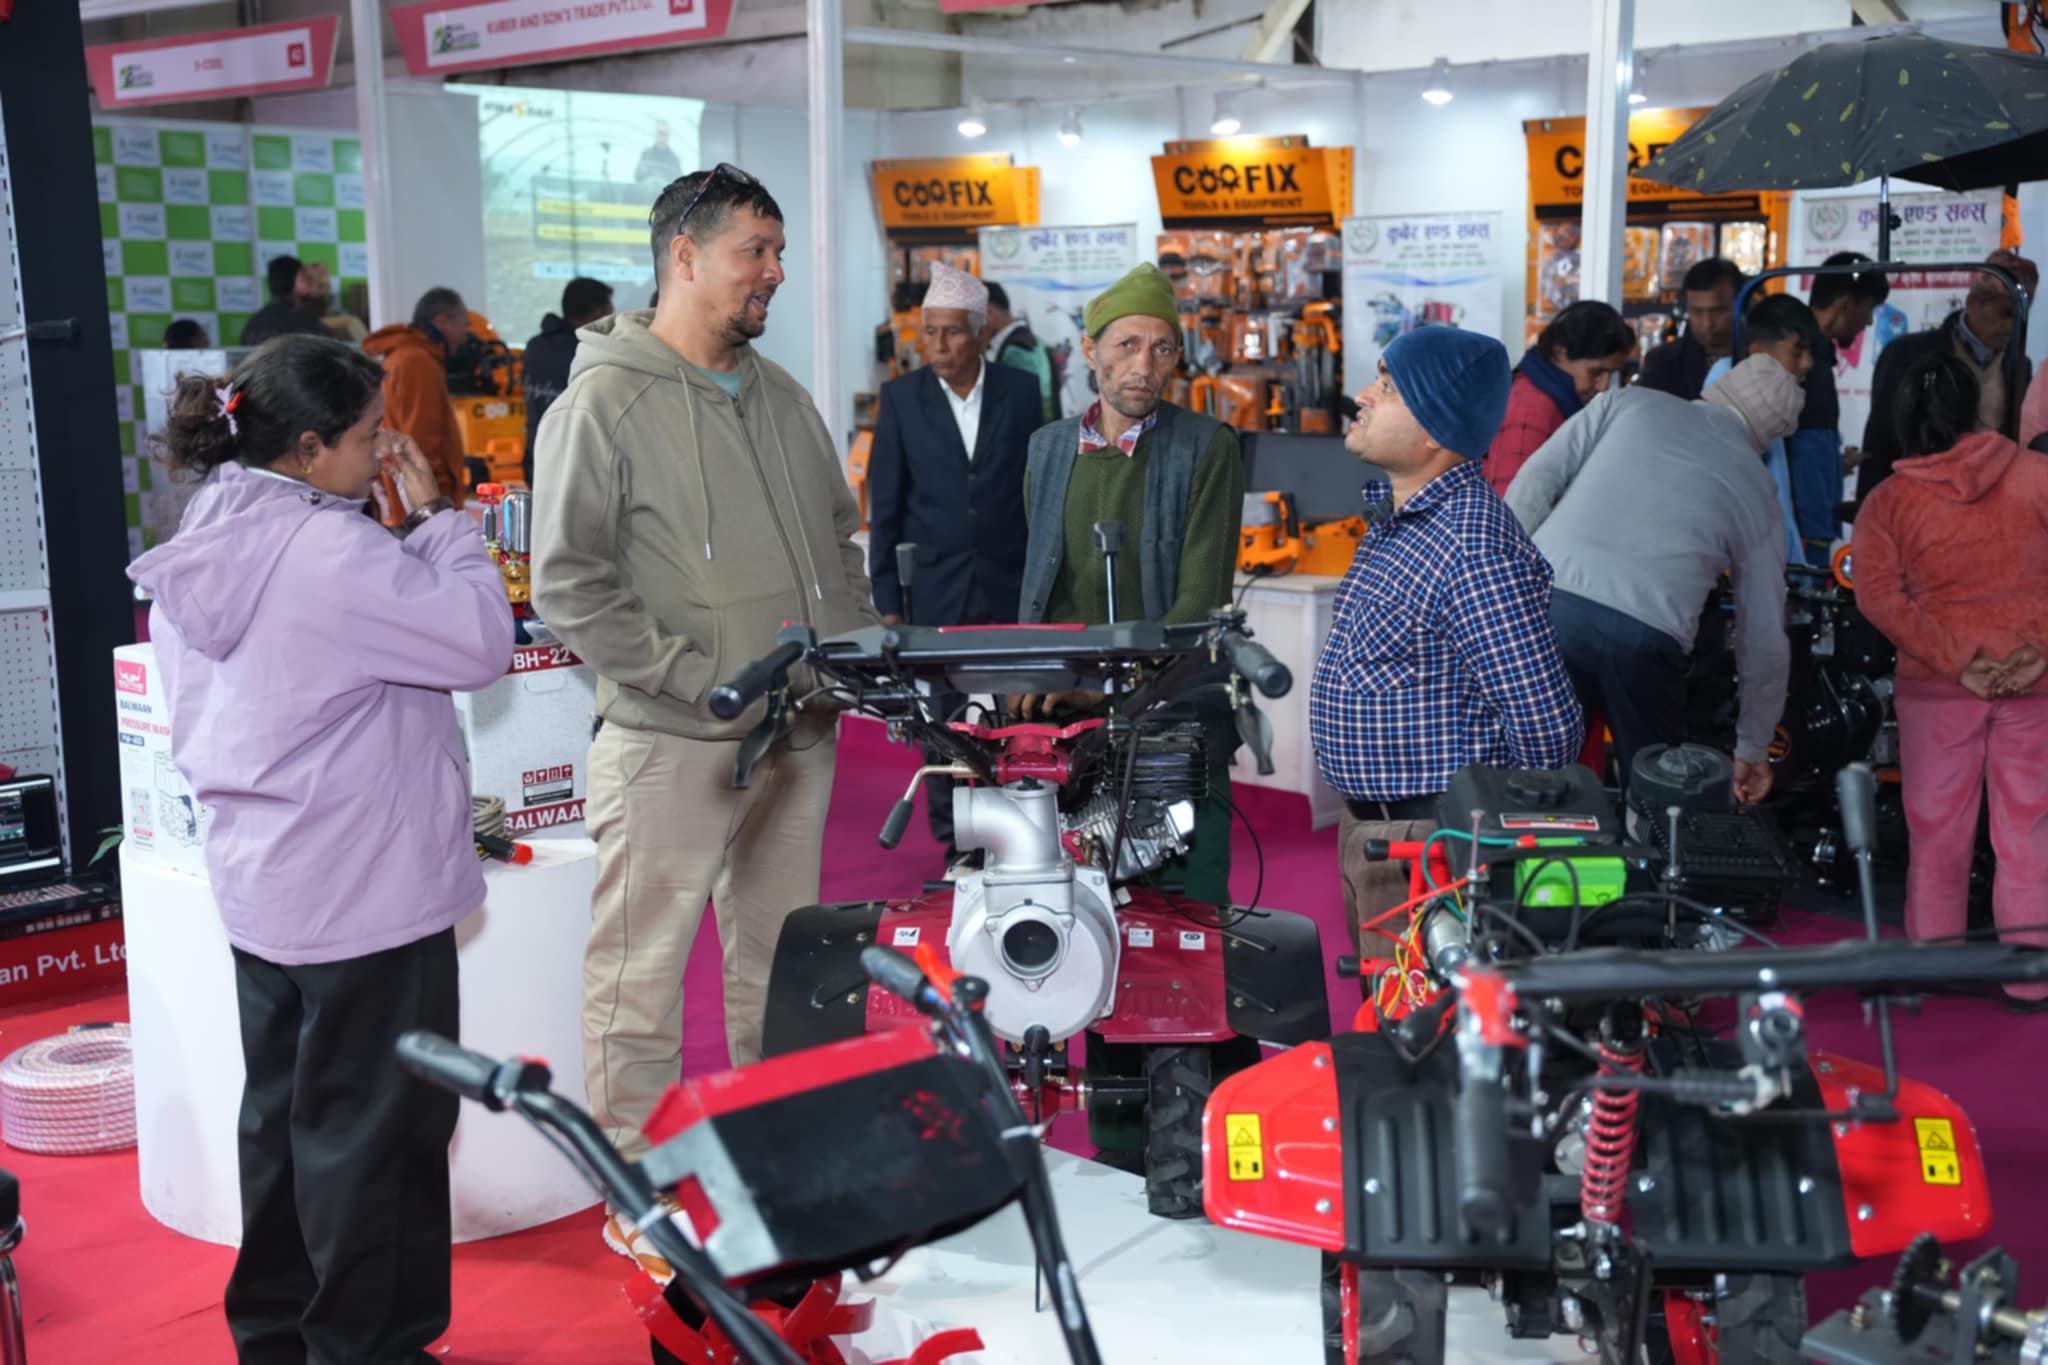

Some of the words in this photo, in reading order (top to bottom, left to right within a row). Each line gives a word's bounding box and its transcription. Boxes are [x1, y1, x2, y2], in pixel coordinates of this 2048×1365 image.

[513, 647, 571, 670] BH-22
[504, 803, 586, 831] BALWAA
[37, 949, 87, 977] Pvt.
